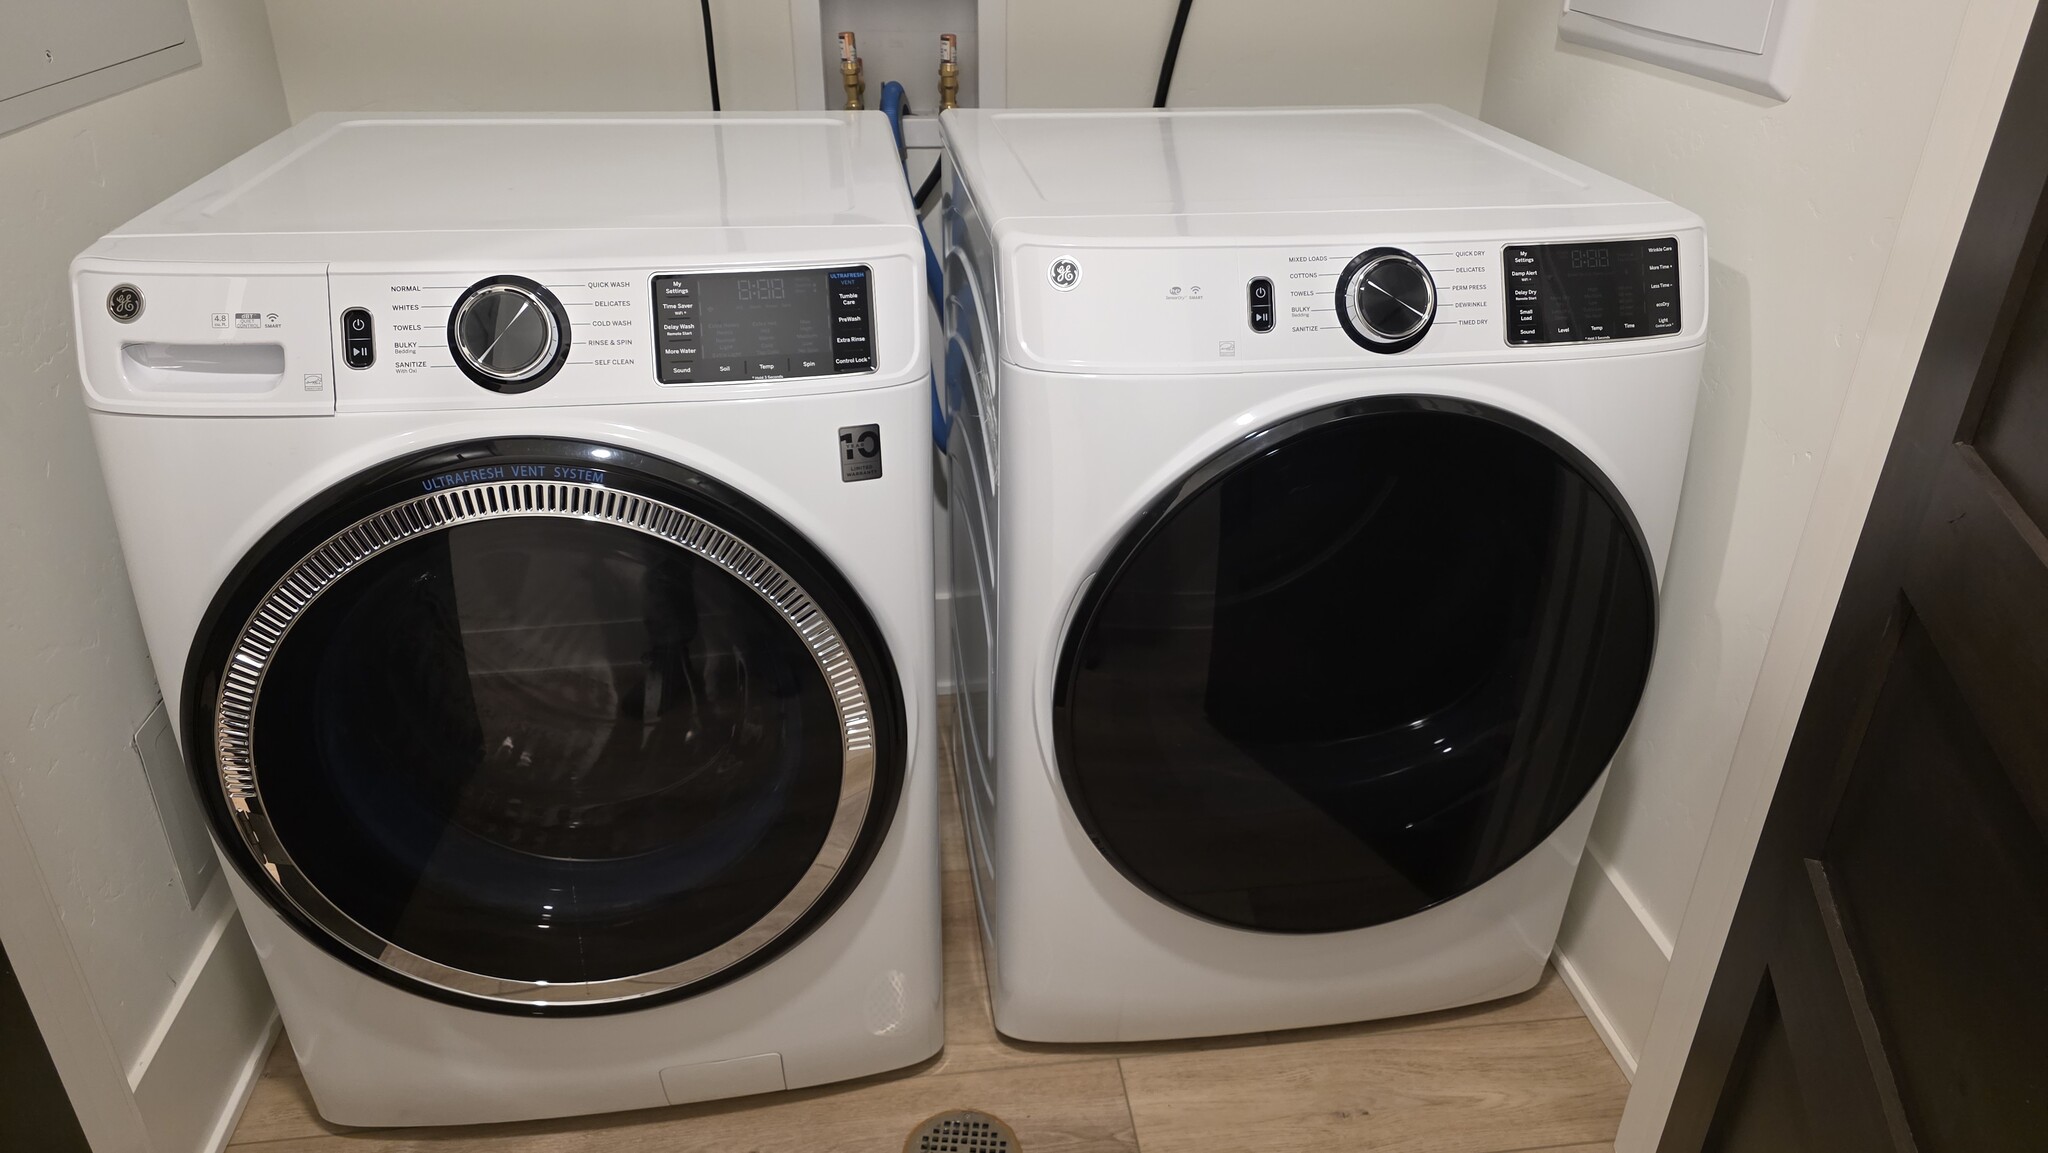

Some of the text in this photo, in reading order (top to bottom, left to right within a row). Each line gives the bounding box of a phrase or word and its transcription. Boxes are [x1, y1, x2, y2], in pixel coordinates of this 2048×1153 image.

[587, 281, 609, 289] QUICK
[838, 315, 861, 323] PreWash
[840, 430, 880, 460] 10
[422, 465, 604, 491] ULTRAFRESH VENT SYSTEM
